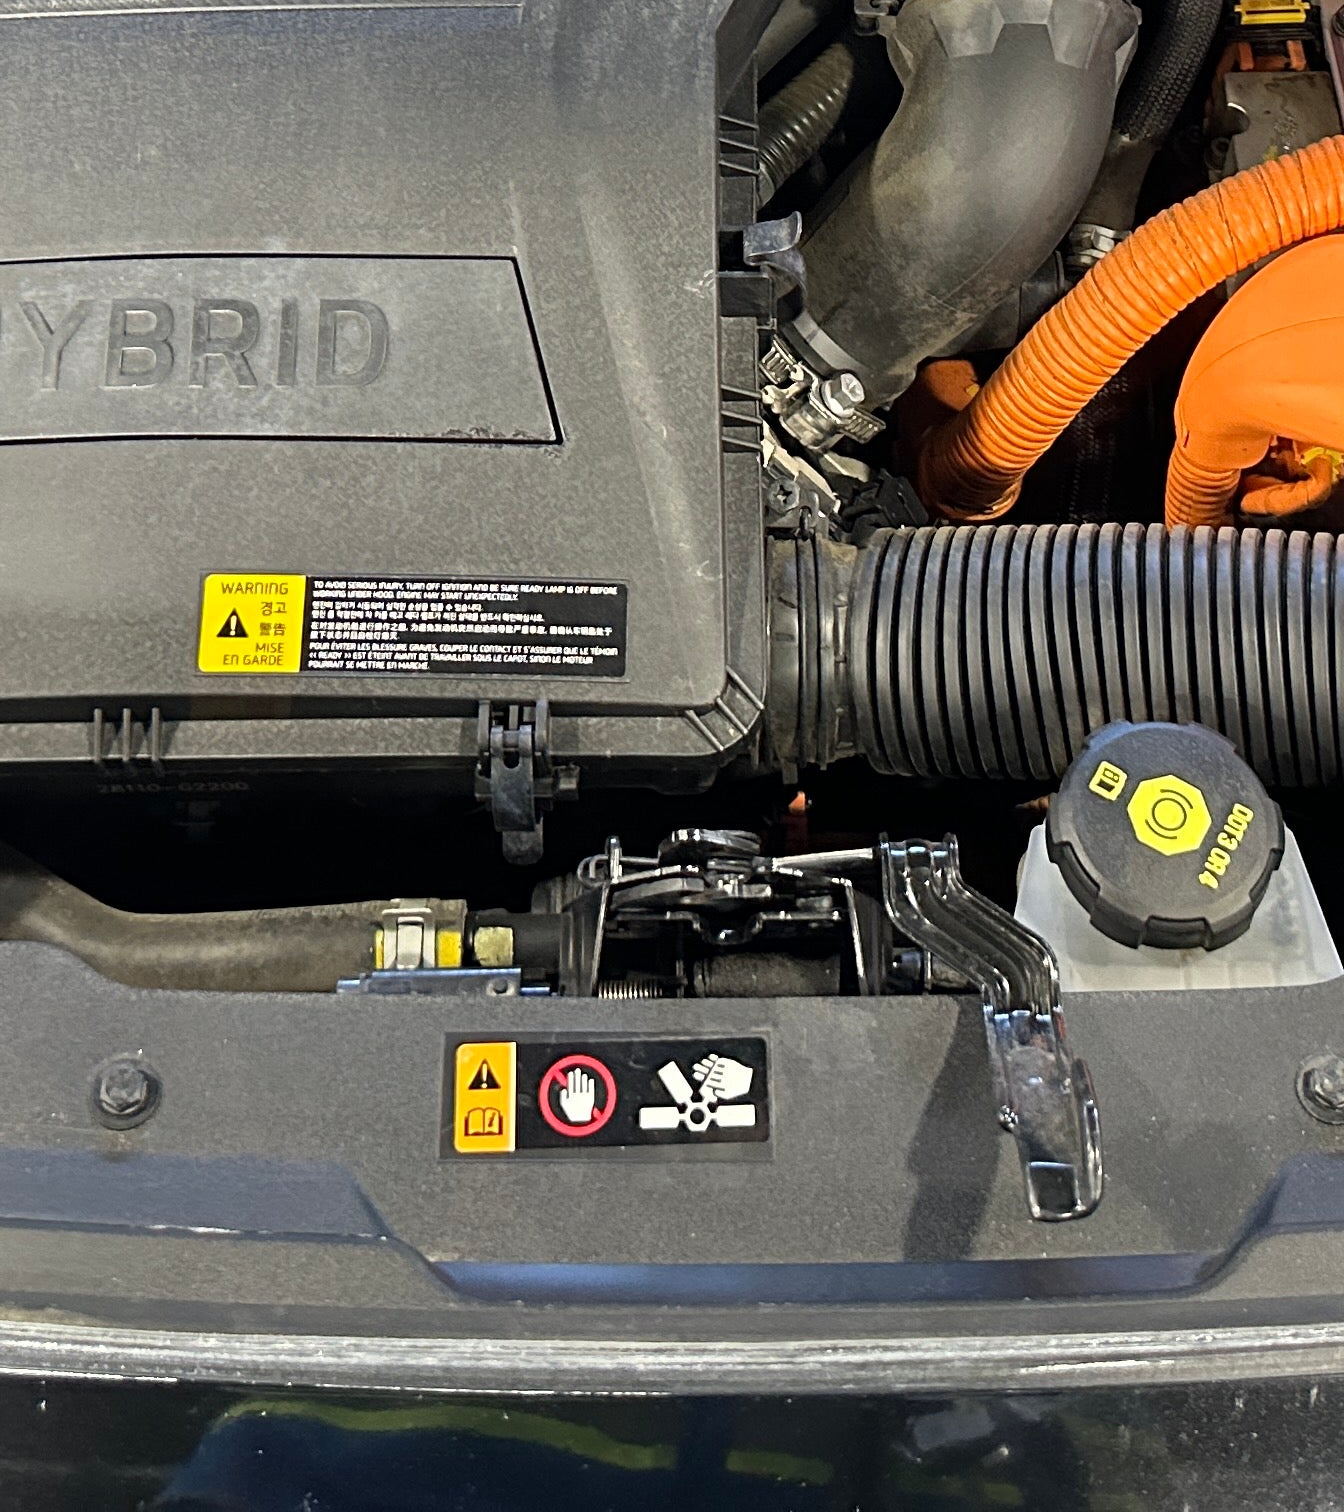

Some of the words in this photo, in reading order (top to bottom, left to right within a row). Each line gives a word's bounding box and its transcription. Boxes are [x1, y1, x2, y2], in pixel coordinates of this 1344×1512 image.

[221, 582, 289, 595] WARNING
[314, 581, 324, 589] TO
[325, 581, 346, 589] AVOID
[348, 582, 377, 590] SERIOUS
[405, 583, 425, 591] TURN
[426, 583, 440, 591] OFF
[473, 584, 489, 592] AND
[490, 584, 499, 592] BE
[520, 585, 544, 593] READY
[574, 586, 589, 594] OFF
[313, 590, 346, 598] WORKING
[396, 591, 422, 599] ENGINE
[423, 592, 440, 600] MAY
[440, 592, 462, 600] START
[260, 601, 287, 616] 경고
[259, 622, 286, 637] 警告
[255, 642, 284, 653] MISE
[309, 642, 330, 650] POUR
[357, 642, 370, 651] LES
[439, 644, 468, 653] COUPER
[469, 644, 478, 653] LE
[479, 645, 511, 653] CONTACT
[512, 645, 522, 654] ET
[563, 646, 578, 655] QUE
[580, 647, 589, 655] LE
[222, 654, 239, 665] EN
[242, 655, 284, 666] GARDE
[308, 660, 344, 668] POURRAIT
[345, 661, 355, 669] SE
[356, 661, 385, 669] METTRE
[386, 661, 397, 669] EN
[352, 652, 366, 660] EST
[394, 653, 417, 661] AVANT
[418, 653, 428, 661] DE
[430, 654, 472, 662] TRAVAILLER
[473, 654, 492, 662] SOUS
[493, 655, 502, 663] LE
[530, 655, 551, 663] SINON
[552, 656, 562, 664] LE
[563, 656, 593, 664] MOTEUR
[1204, 847, 1232, 877] OR
[1198, 870, 1219, 890] 4
